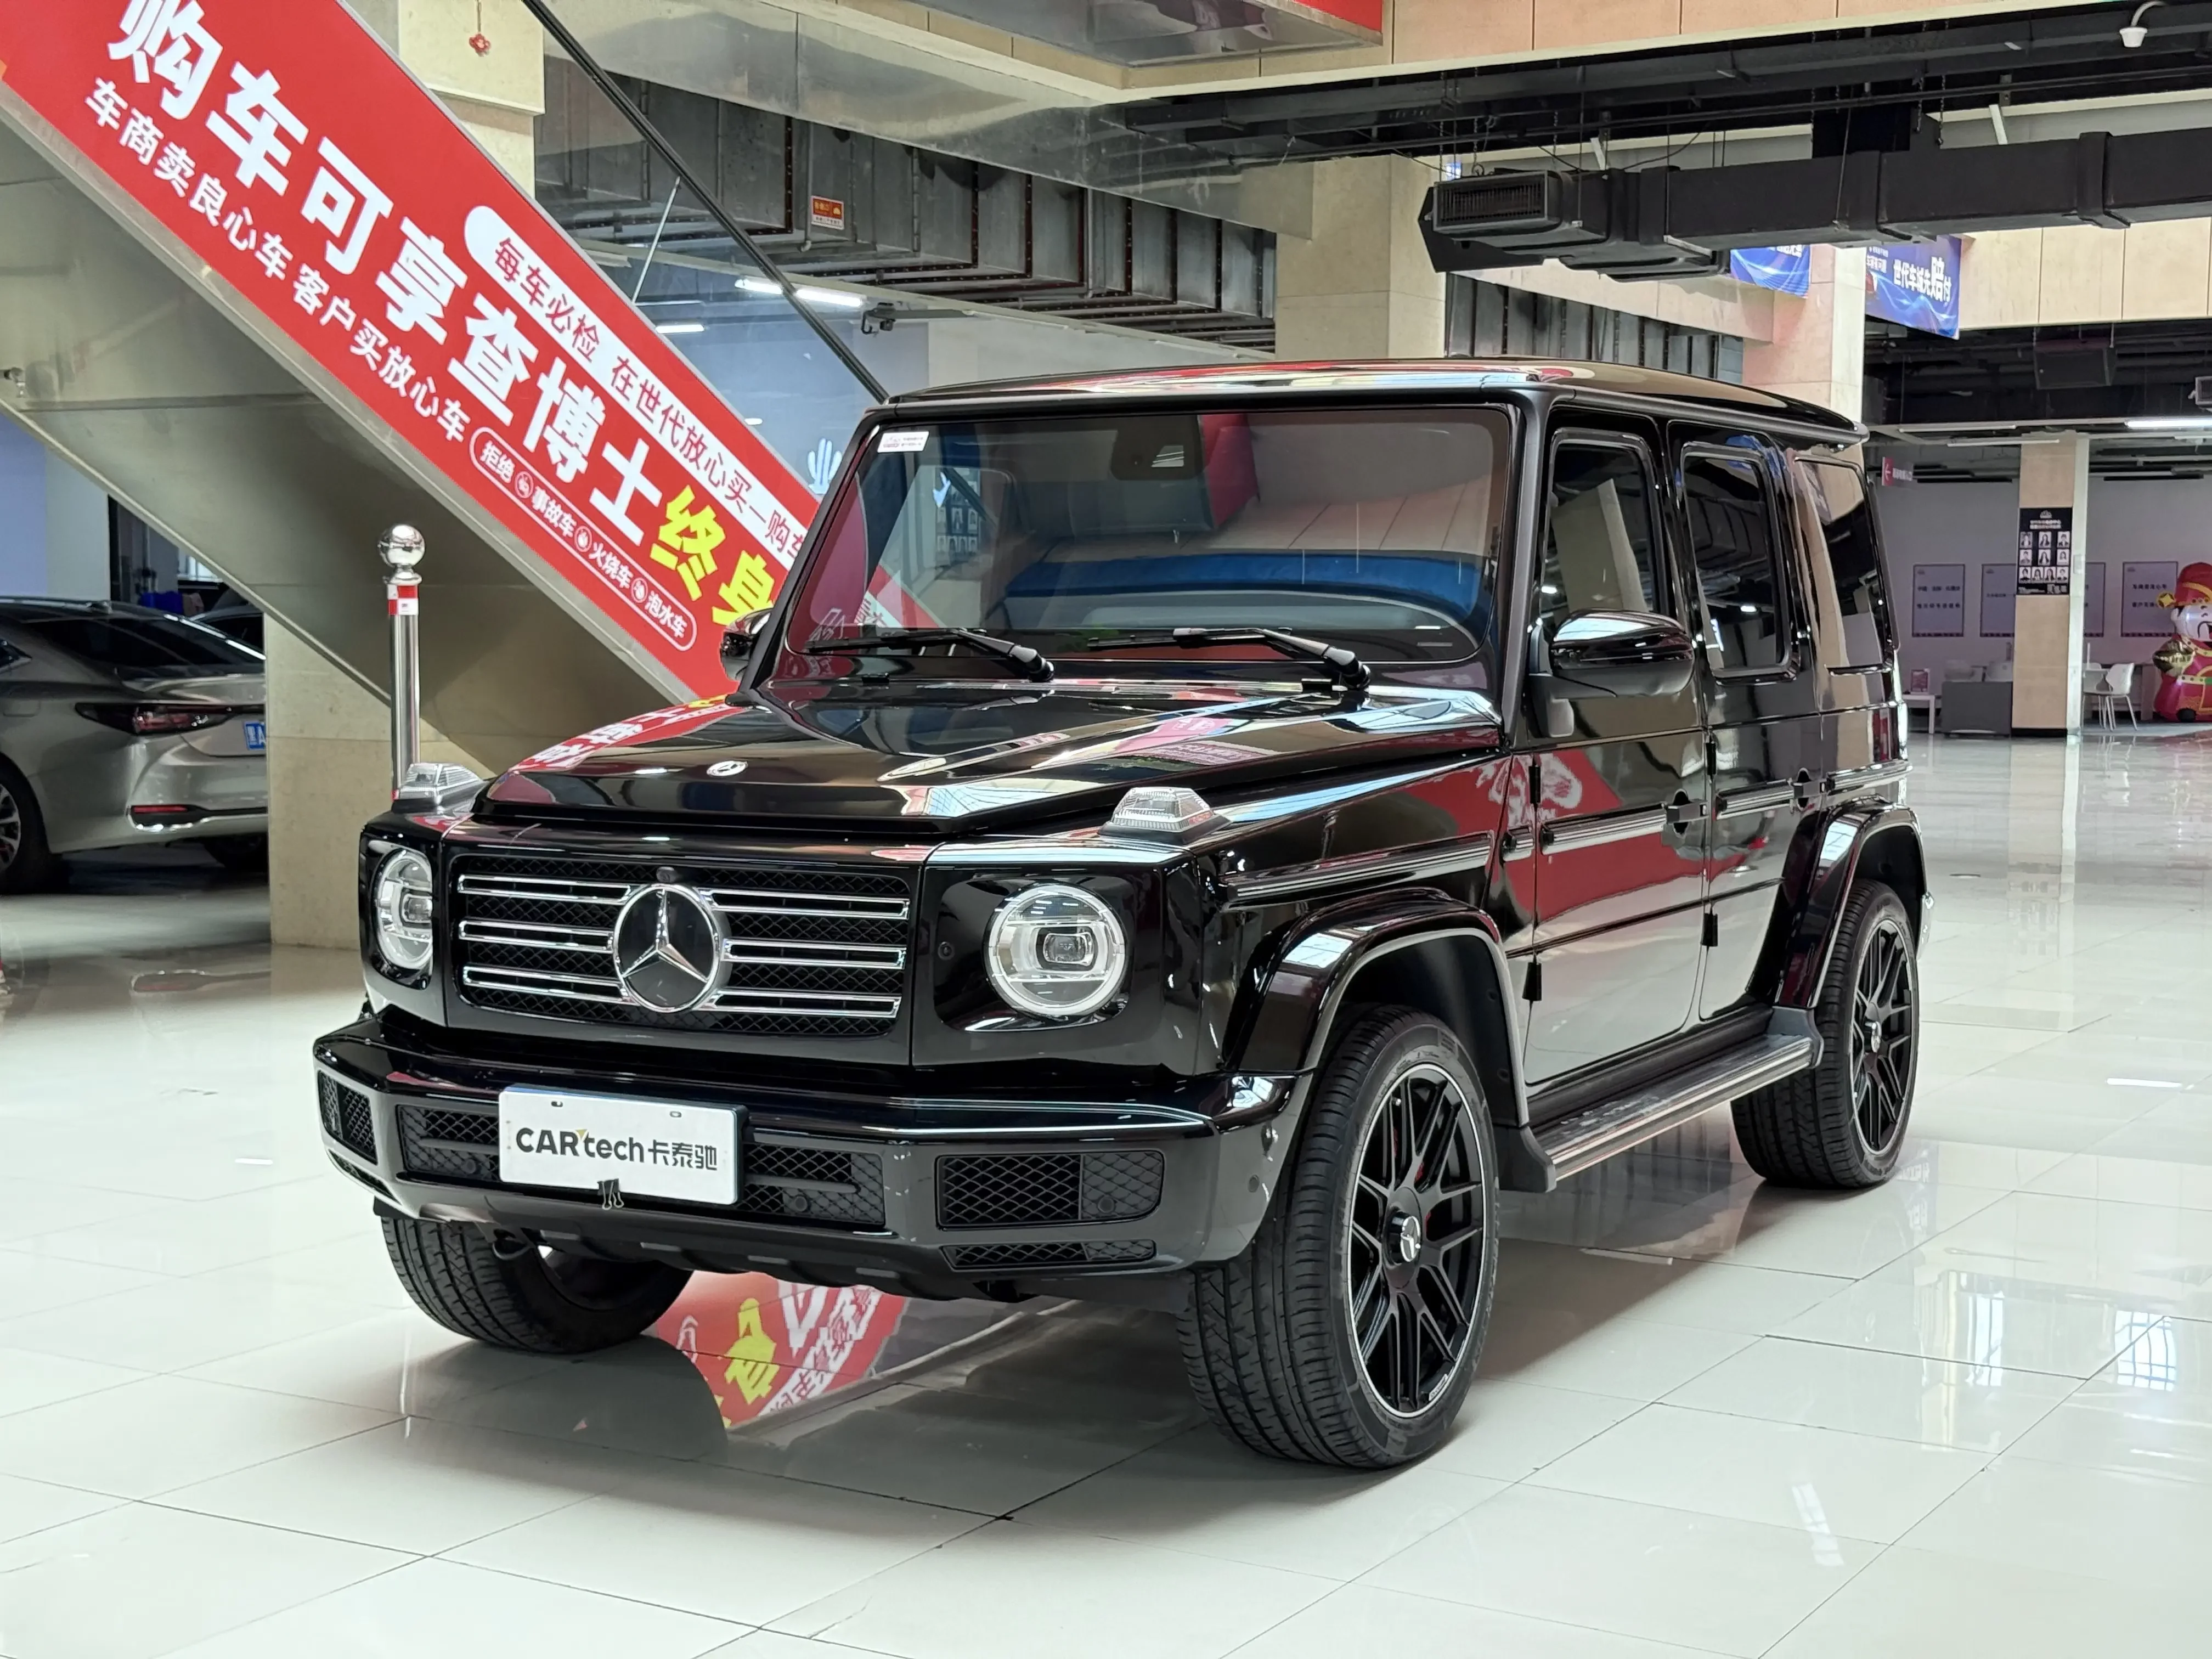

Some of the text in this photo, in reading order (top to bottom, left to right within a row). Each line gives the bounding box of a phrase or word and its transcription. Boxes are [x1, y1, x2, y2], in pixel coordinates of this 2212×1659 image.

[84, 77, 471, 443] 车商卖良心车 客户买放心车
[494, 238, 601, 363] 每车必检
[480, 441, 688, 639] 拒绝 事故车 火烧车 泡水车
[516, 1127, 718, 1171] CARtech 卡泰驰
